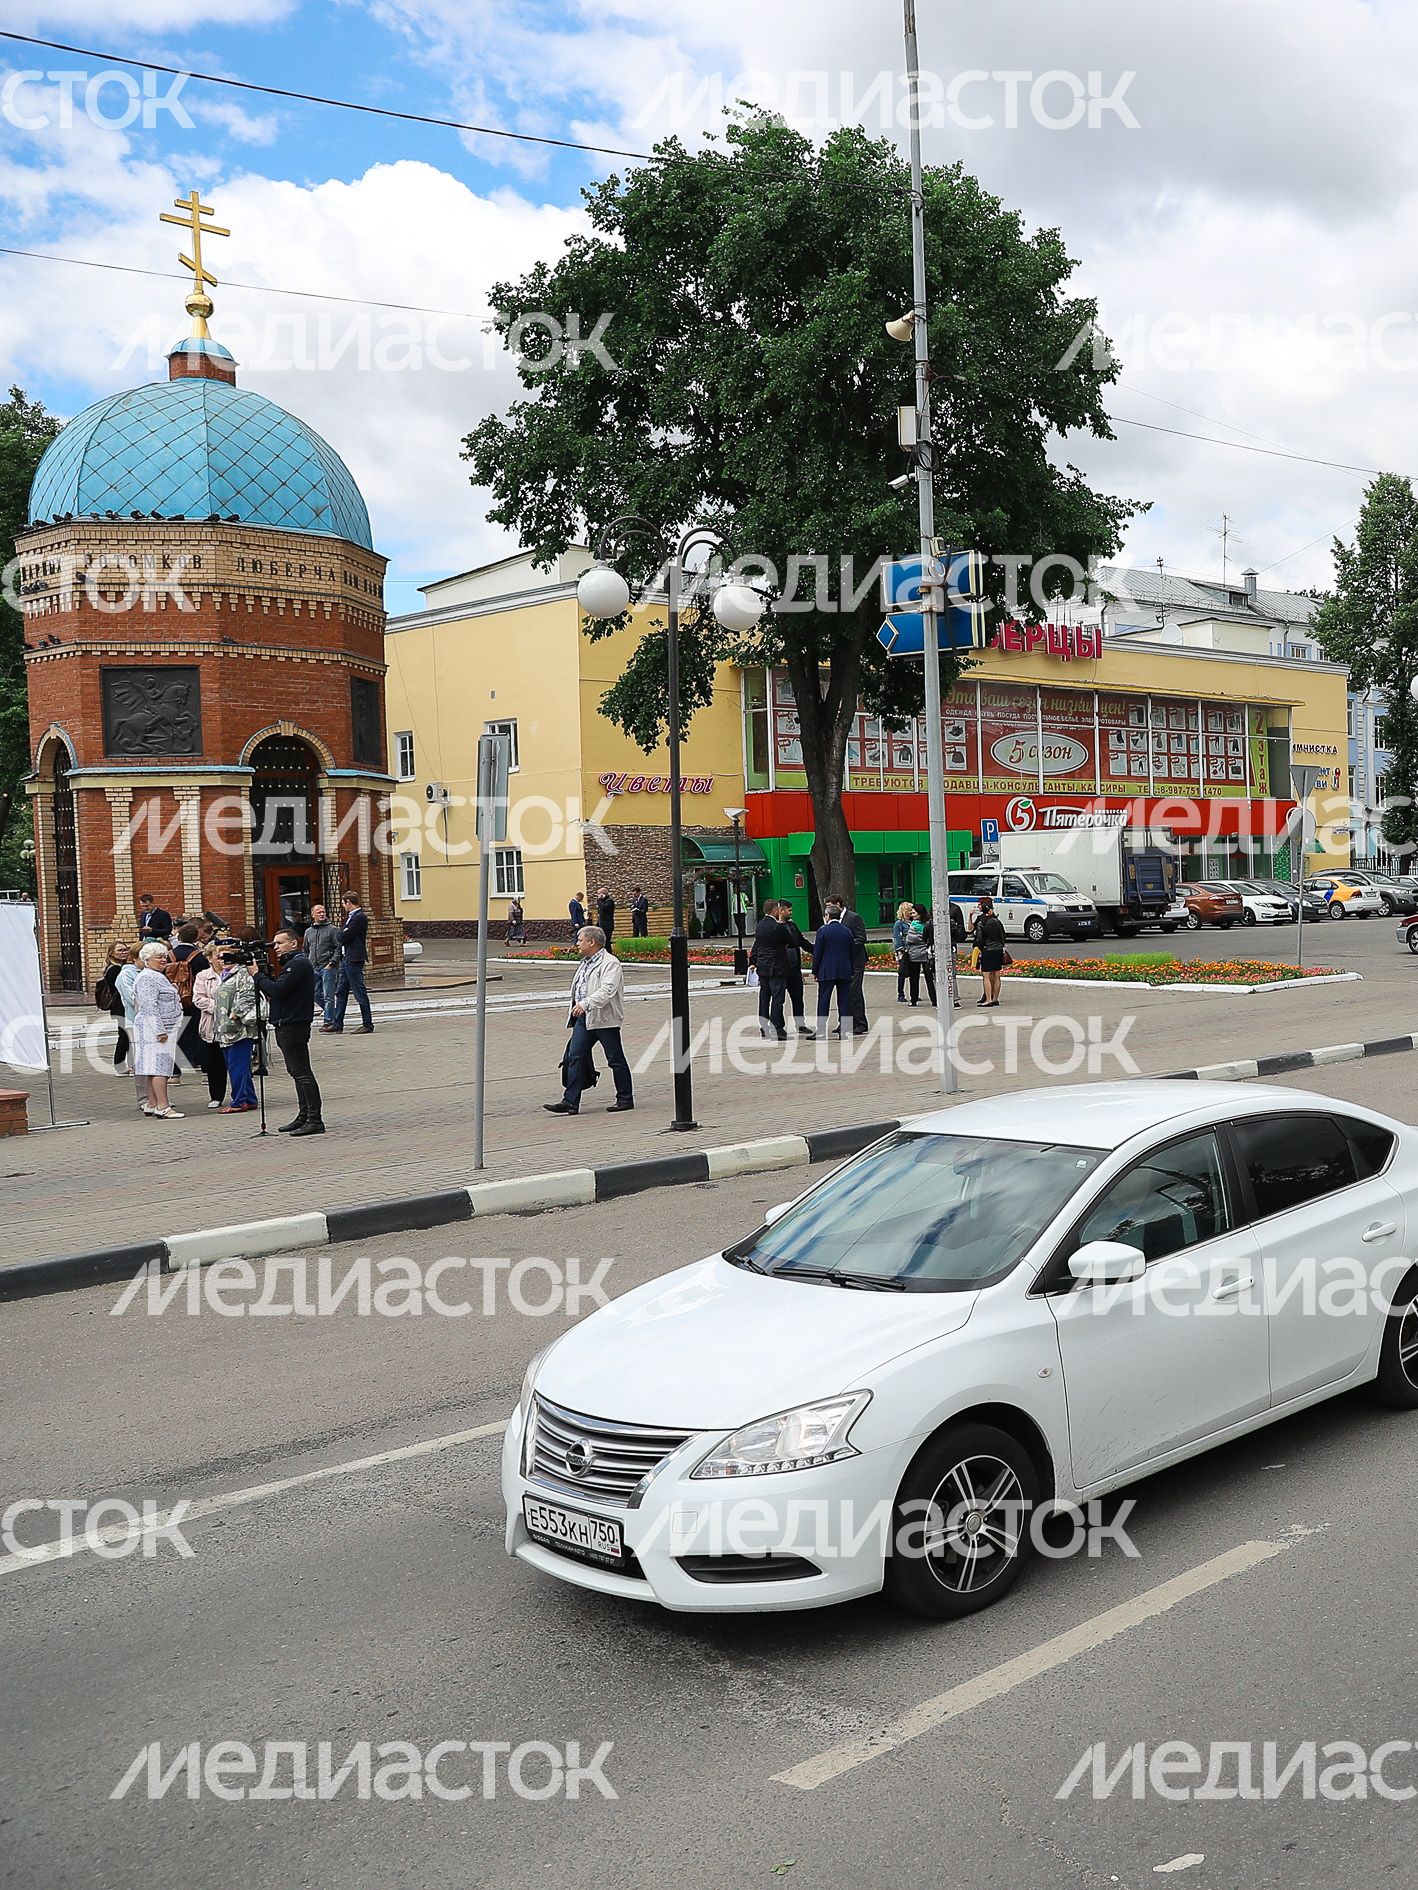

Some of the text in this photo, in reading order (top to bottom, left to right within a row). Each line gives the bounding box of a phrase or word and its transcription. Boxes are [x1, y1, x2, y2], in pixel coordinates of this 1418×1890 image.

[1051, 697, 1094, 716] низки
[1255, 710, 1264, 734] 2
[1009, 739, 1073, 764] 5 сзон
[1292, 743, 1338, 754] ИМЧИСТКА
[530, 1505, 615, 1544] Е553КН 750
